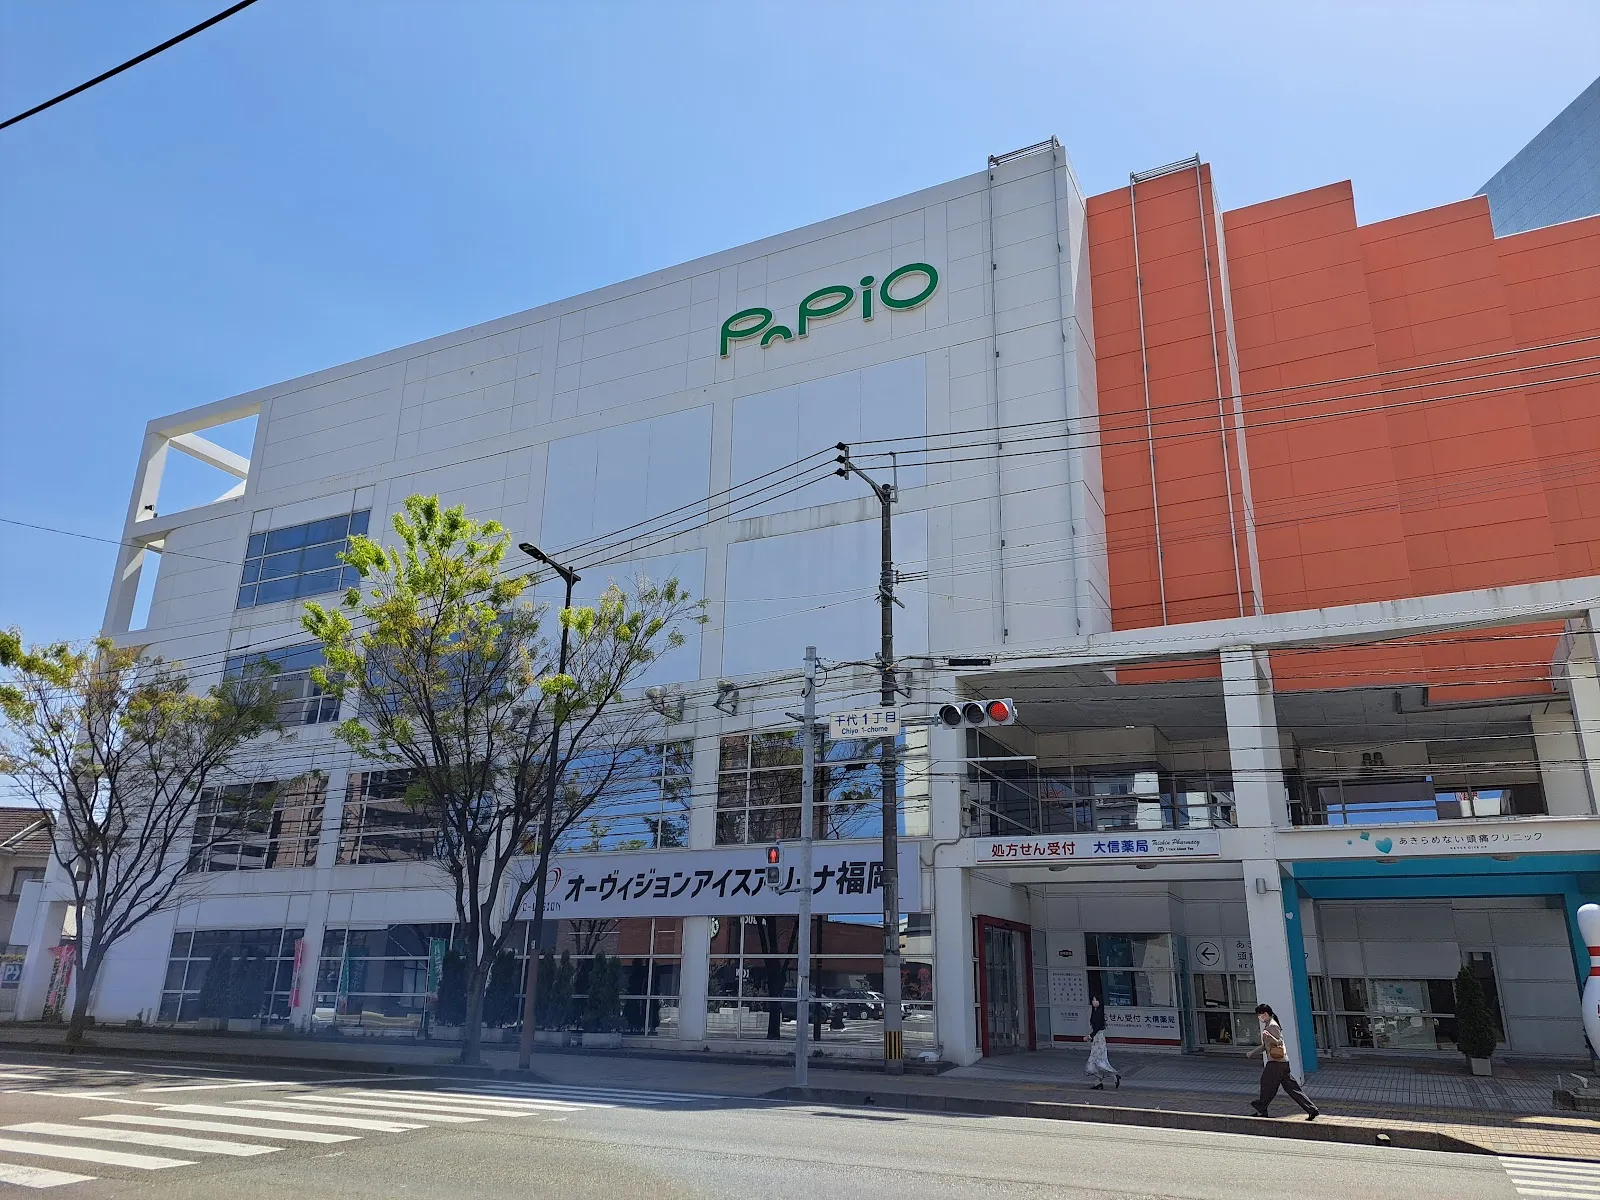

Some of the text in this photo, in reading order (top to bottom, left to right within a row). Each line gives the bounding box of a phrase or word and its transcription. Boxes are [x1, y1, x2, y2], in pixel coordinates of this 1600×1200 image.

[836, 711, 896, 727] 千代1丁目
[841, 725, 888, 736] Chiyo 1-chome
[1172, 838, 1200, 847] Pharmacy
[1399, 832, 1542, 845] あきらめない頭痛クリニック
[992, 839, 1149, 857] 処方せん受付 大信薬局
[1144, 1015, 1175, 1023] 大信薬局
